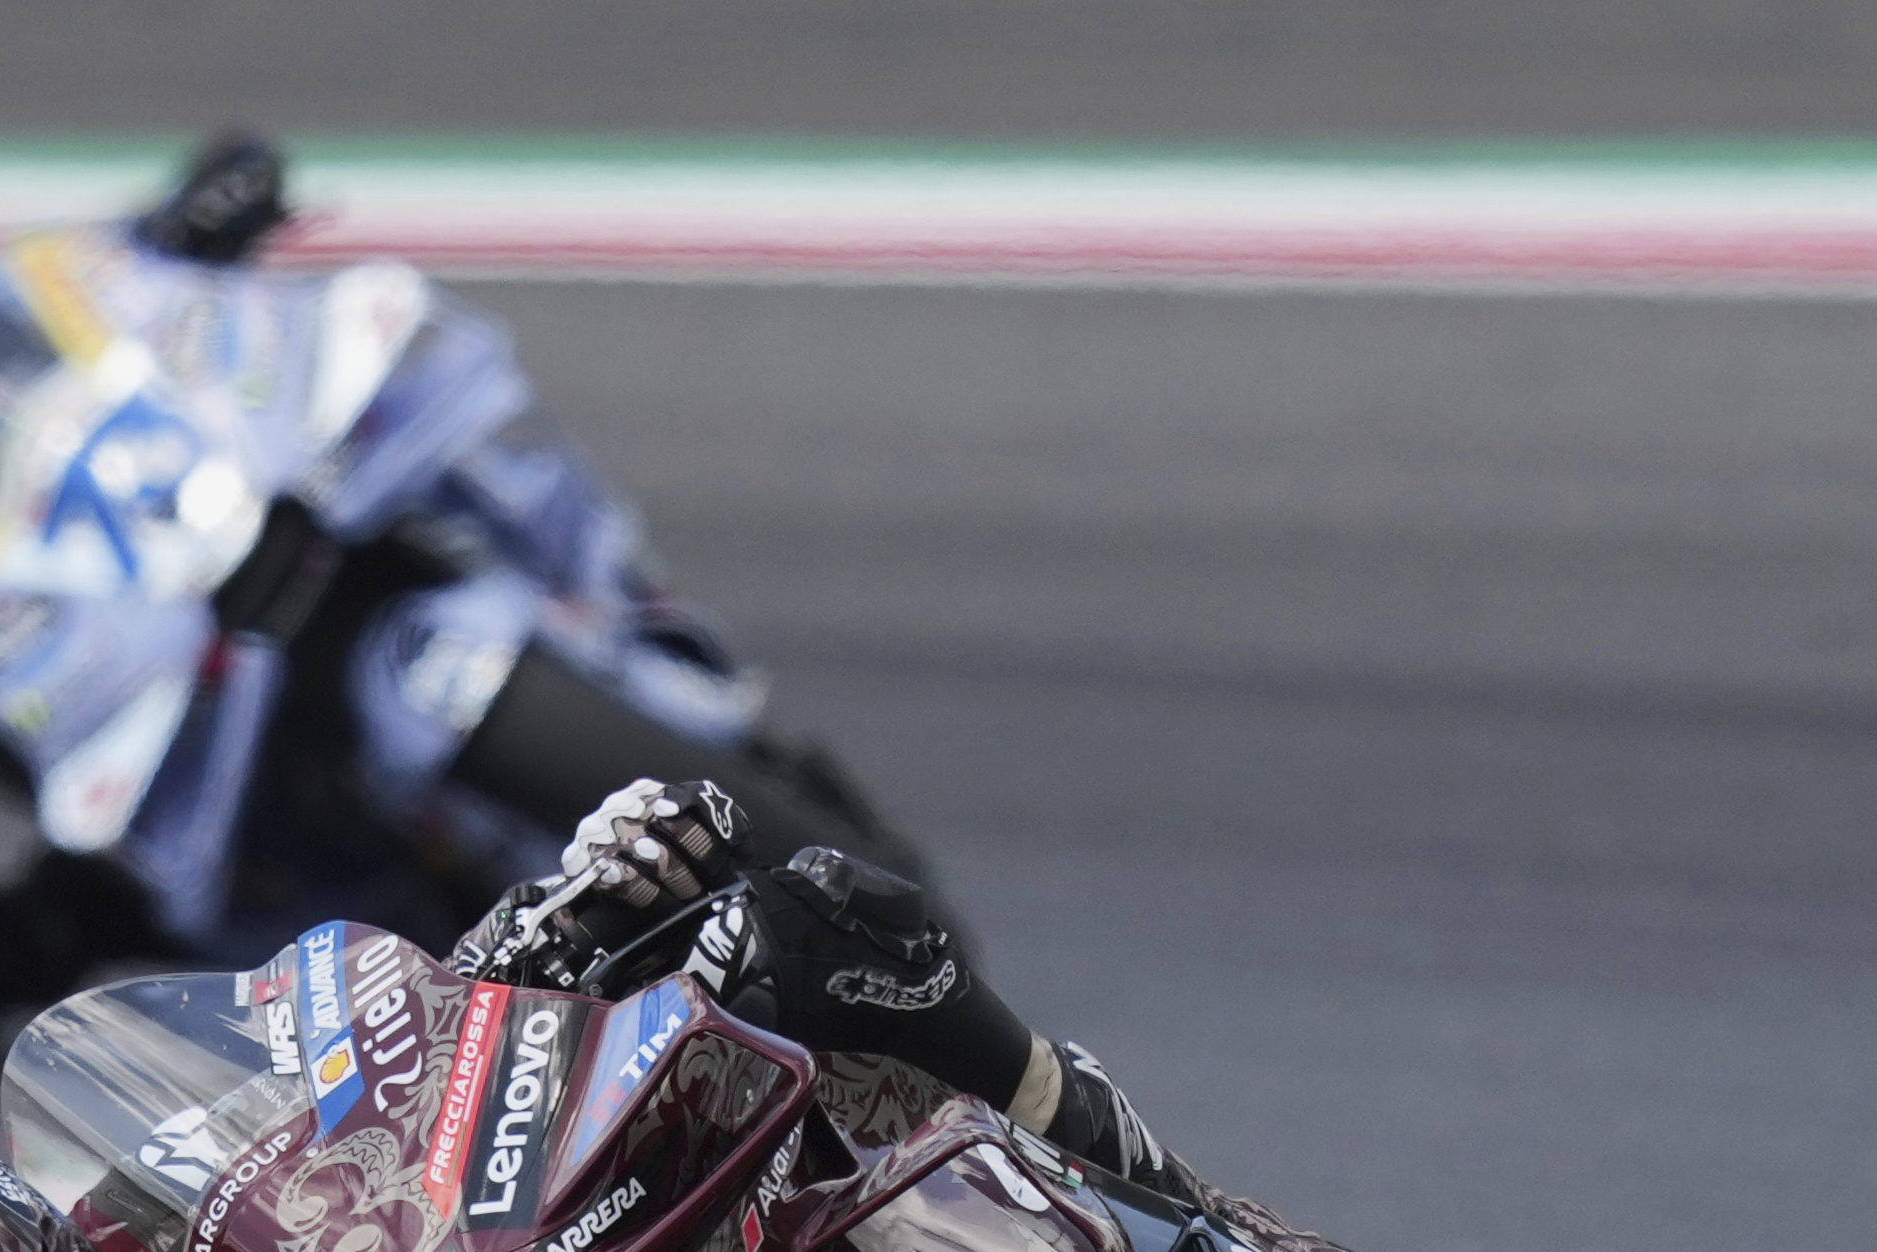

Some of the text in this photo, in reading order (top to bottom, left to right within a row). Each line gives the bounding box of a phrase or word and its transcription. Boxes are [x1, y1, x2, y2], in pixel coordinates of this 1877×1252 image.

[304, 929, 342, 1030] ADVANCE
[266, 1002, 301, 1075] WRS
[429, 989, 494, 1185] FRECCIAROSSA
[619, 1013, 683, 1080] TIM
[469, 1011, 560, 1216] Lenovo
